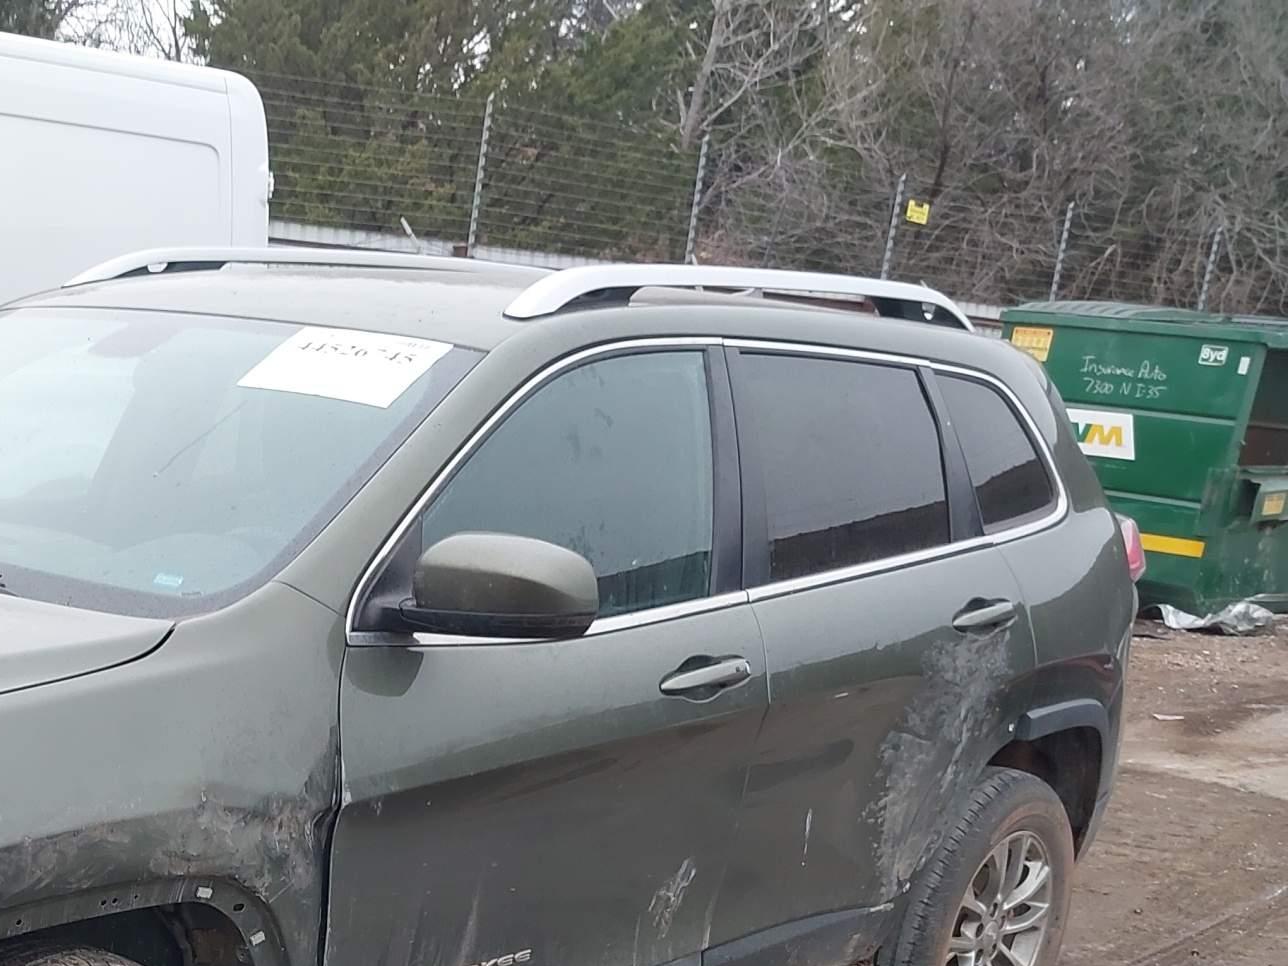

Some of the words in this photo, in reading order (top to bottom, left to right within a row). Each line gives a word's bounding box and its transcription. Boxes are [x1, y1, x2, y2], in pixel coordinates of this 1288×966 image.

[1137, 360, 1167, 381] Auto
[1083, 377, 1114, 394] 7300
[1119, 382, 1132, 395] N
[1135, 383, 1167, 399] I-35
